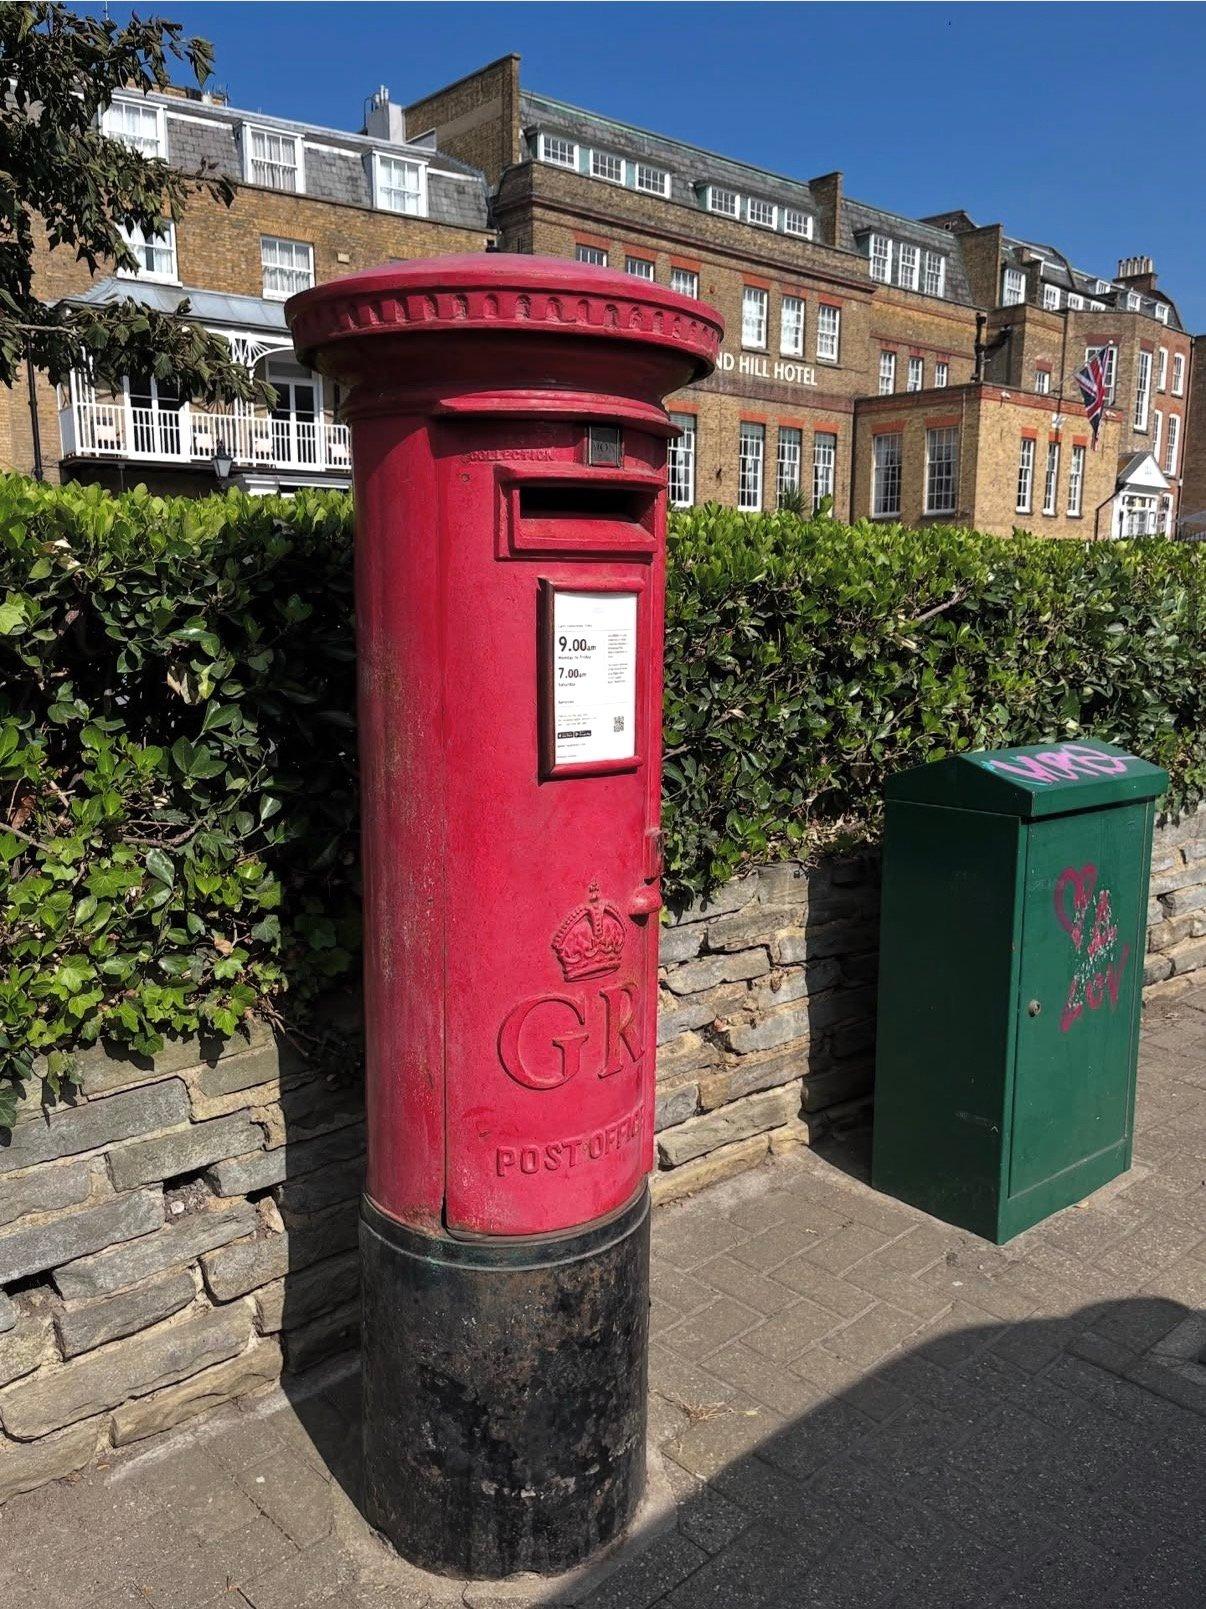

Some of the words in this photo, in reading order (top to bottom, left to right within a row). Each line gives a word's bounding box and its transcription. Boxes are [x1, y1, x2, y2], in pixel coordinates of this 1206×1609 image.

[739, 355, 770, 378] HILL
[774, 362, 818, 386] HOTEL
[558, 636, 597, 652] 9.00am
[558, 667, 587, 679] 7.00am
[497, 984, 645, 1091] GR
[496, 1136, 582, 1177] POST
